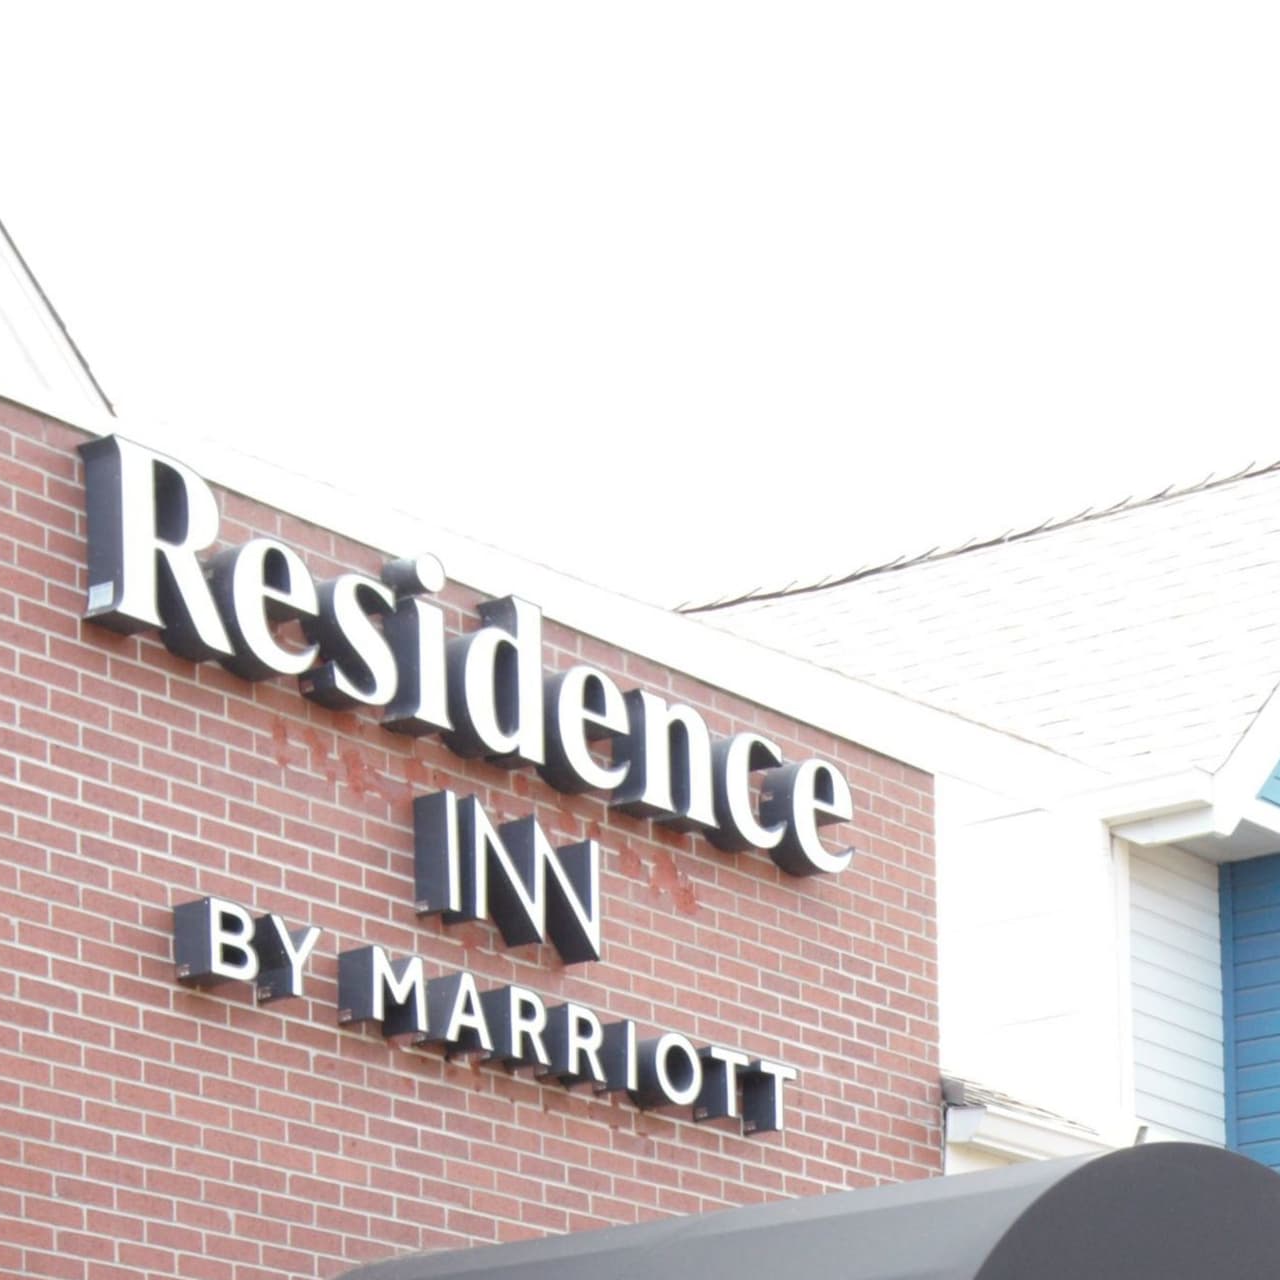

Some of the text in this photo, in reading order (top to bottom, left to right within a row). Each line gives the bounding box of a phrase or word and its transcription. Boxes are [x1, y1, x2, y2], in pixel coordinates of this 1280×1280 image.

[80, 434, 857, 877] Residence
[413, 789, 601, 964] INN
[173, 895, 798, 1135] BY MARRIOTT
